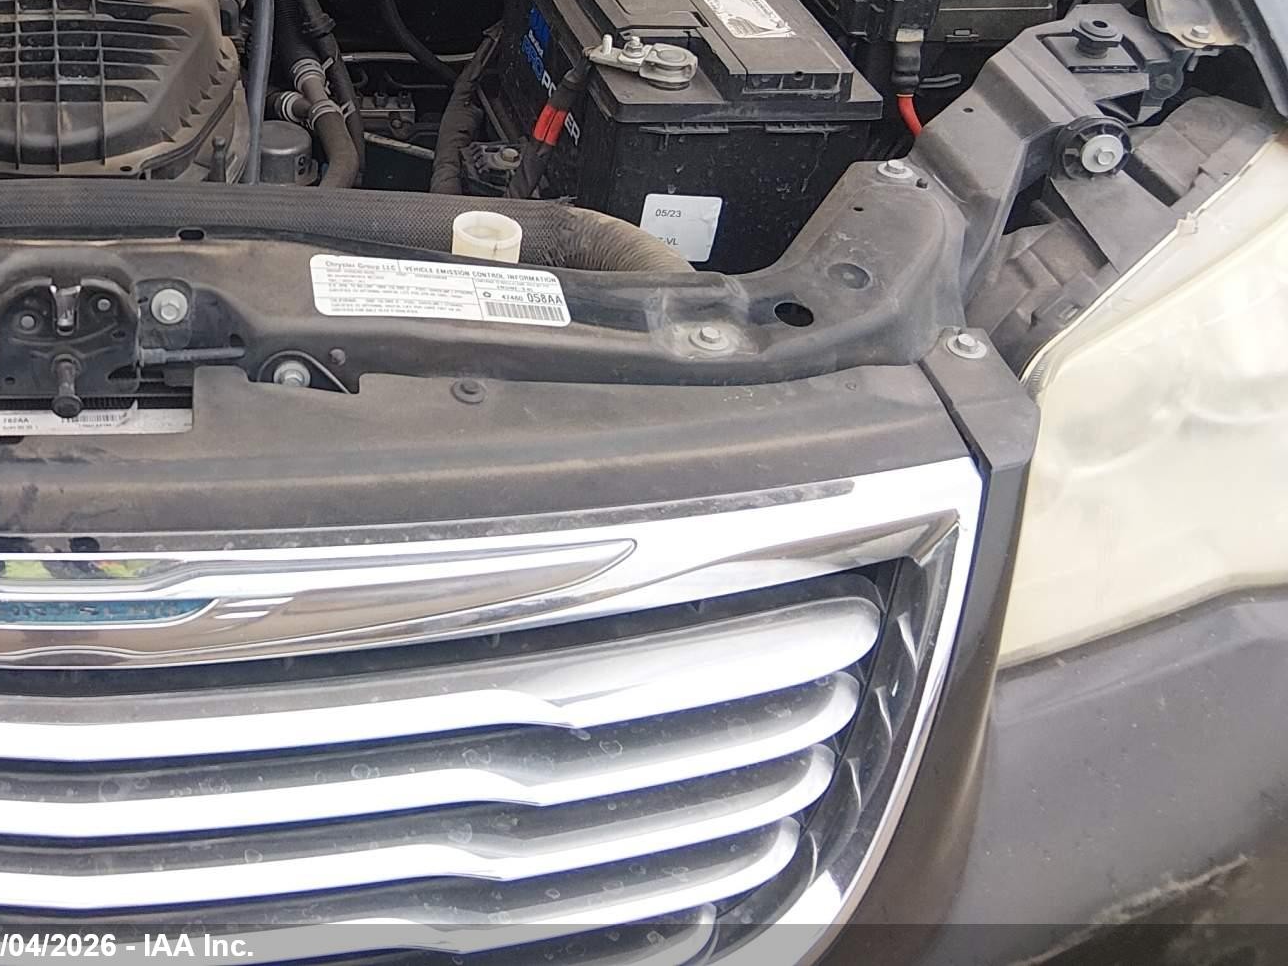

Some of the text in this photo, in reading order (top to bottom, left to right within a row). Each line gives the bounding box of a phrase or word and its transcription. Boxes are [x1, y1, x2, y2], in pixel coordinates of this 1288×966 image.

[655, 208, 682, 218] 05/23
[404, 266, 434, 275] VEHICLE
[436, 268, 470, 277] EMISSION
[472, 271, 505, 280] CONTROL
[507, 274, 557, 283] INFORMATION
[527, 292, 563, 305] 058AA
